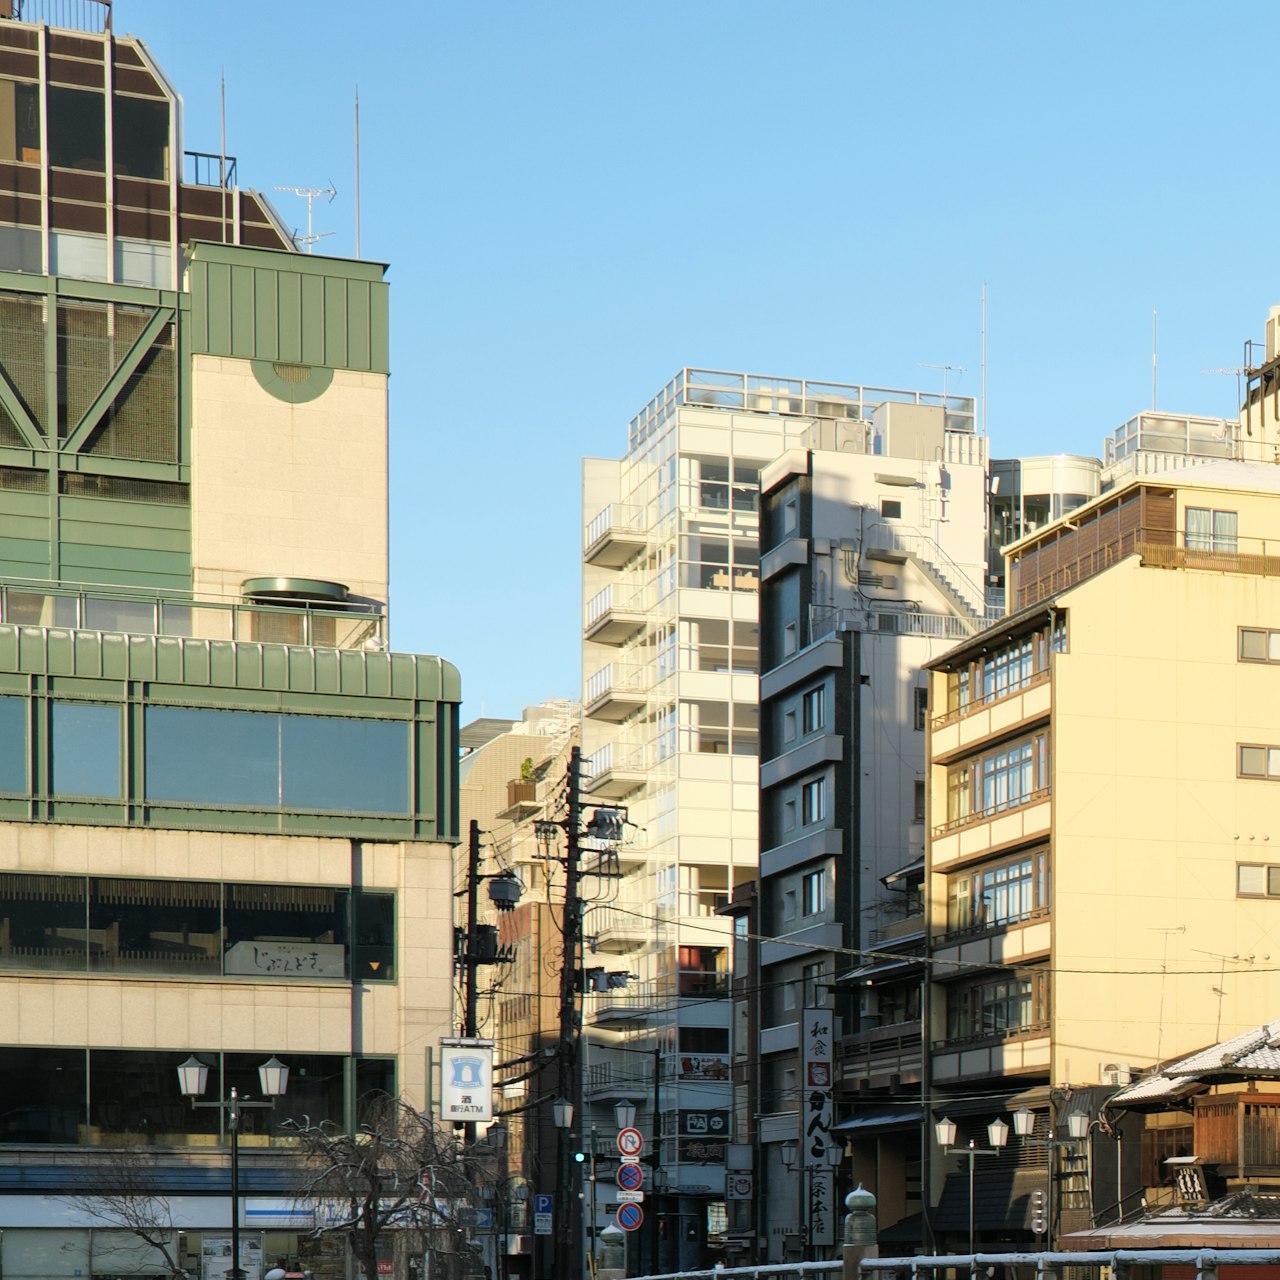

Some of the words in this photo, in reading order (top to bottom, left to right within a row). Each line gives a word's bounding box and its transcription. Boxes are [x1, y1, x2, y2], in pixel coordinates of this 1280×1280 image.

[810, 1021, 828, 1057] 和食
[808, 1088, 832, 1158] がんこ
